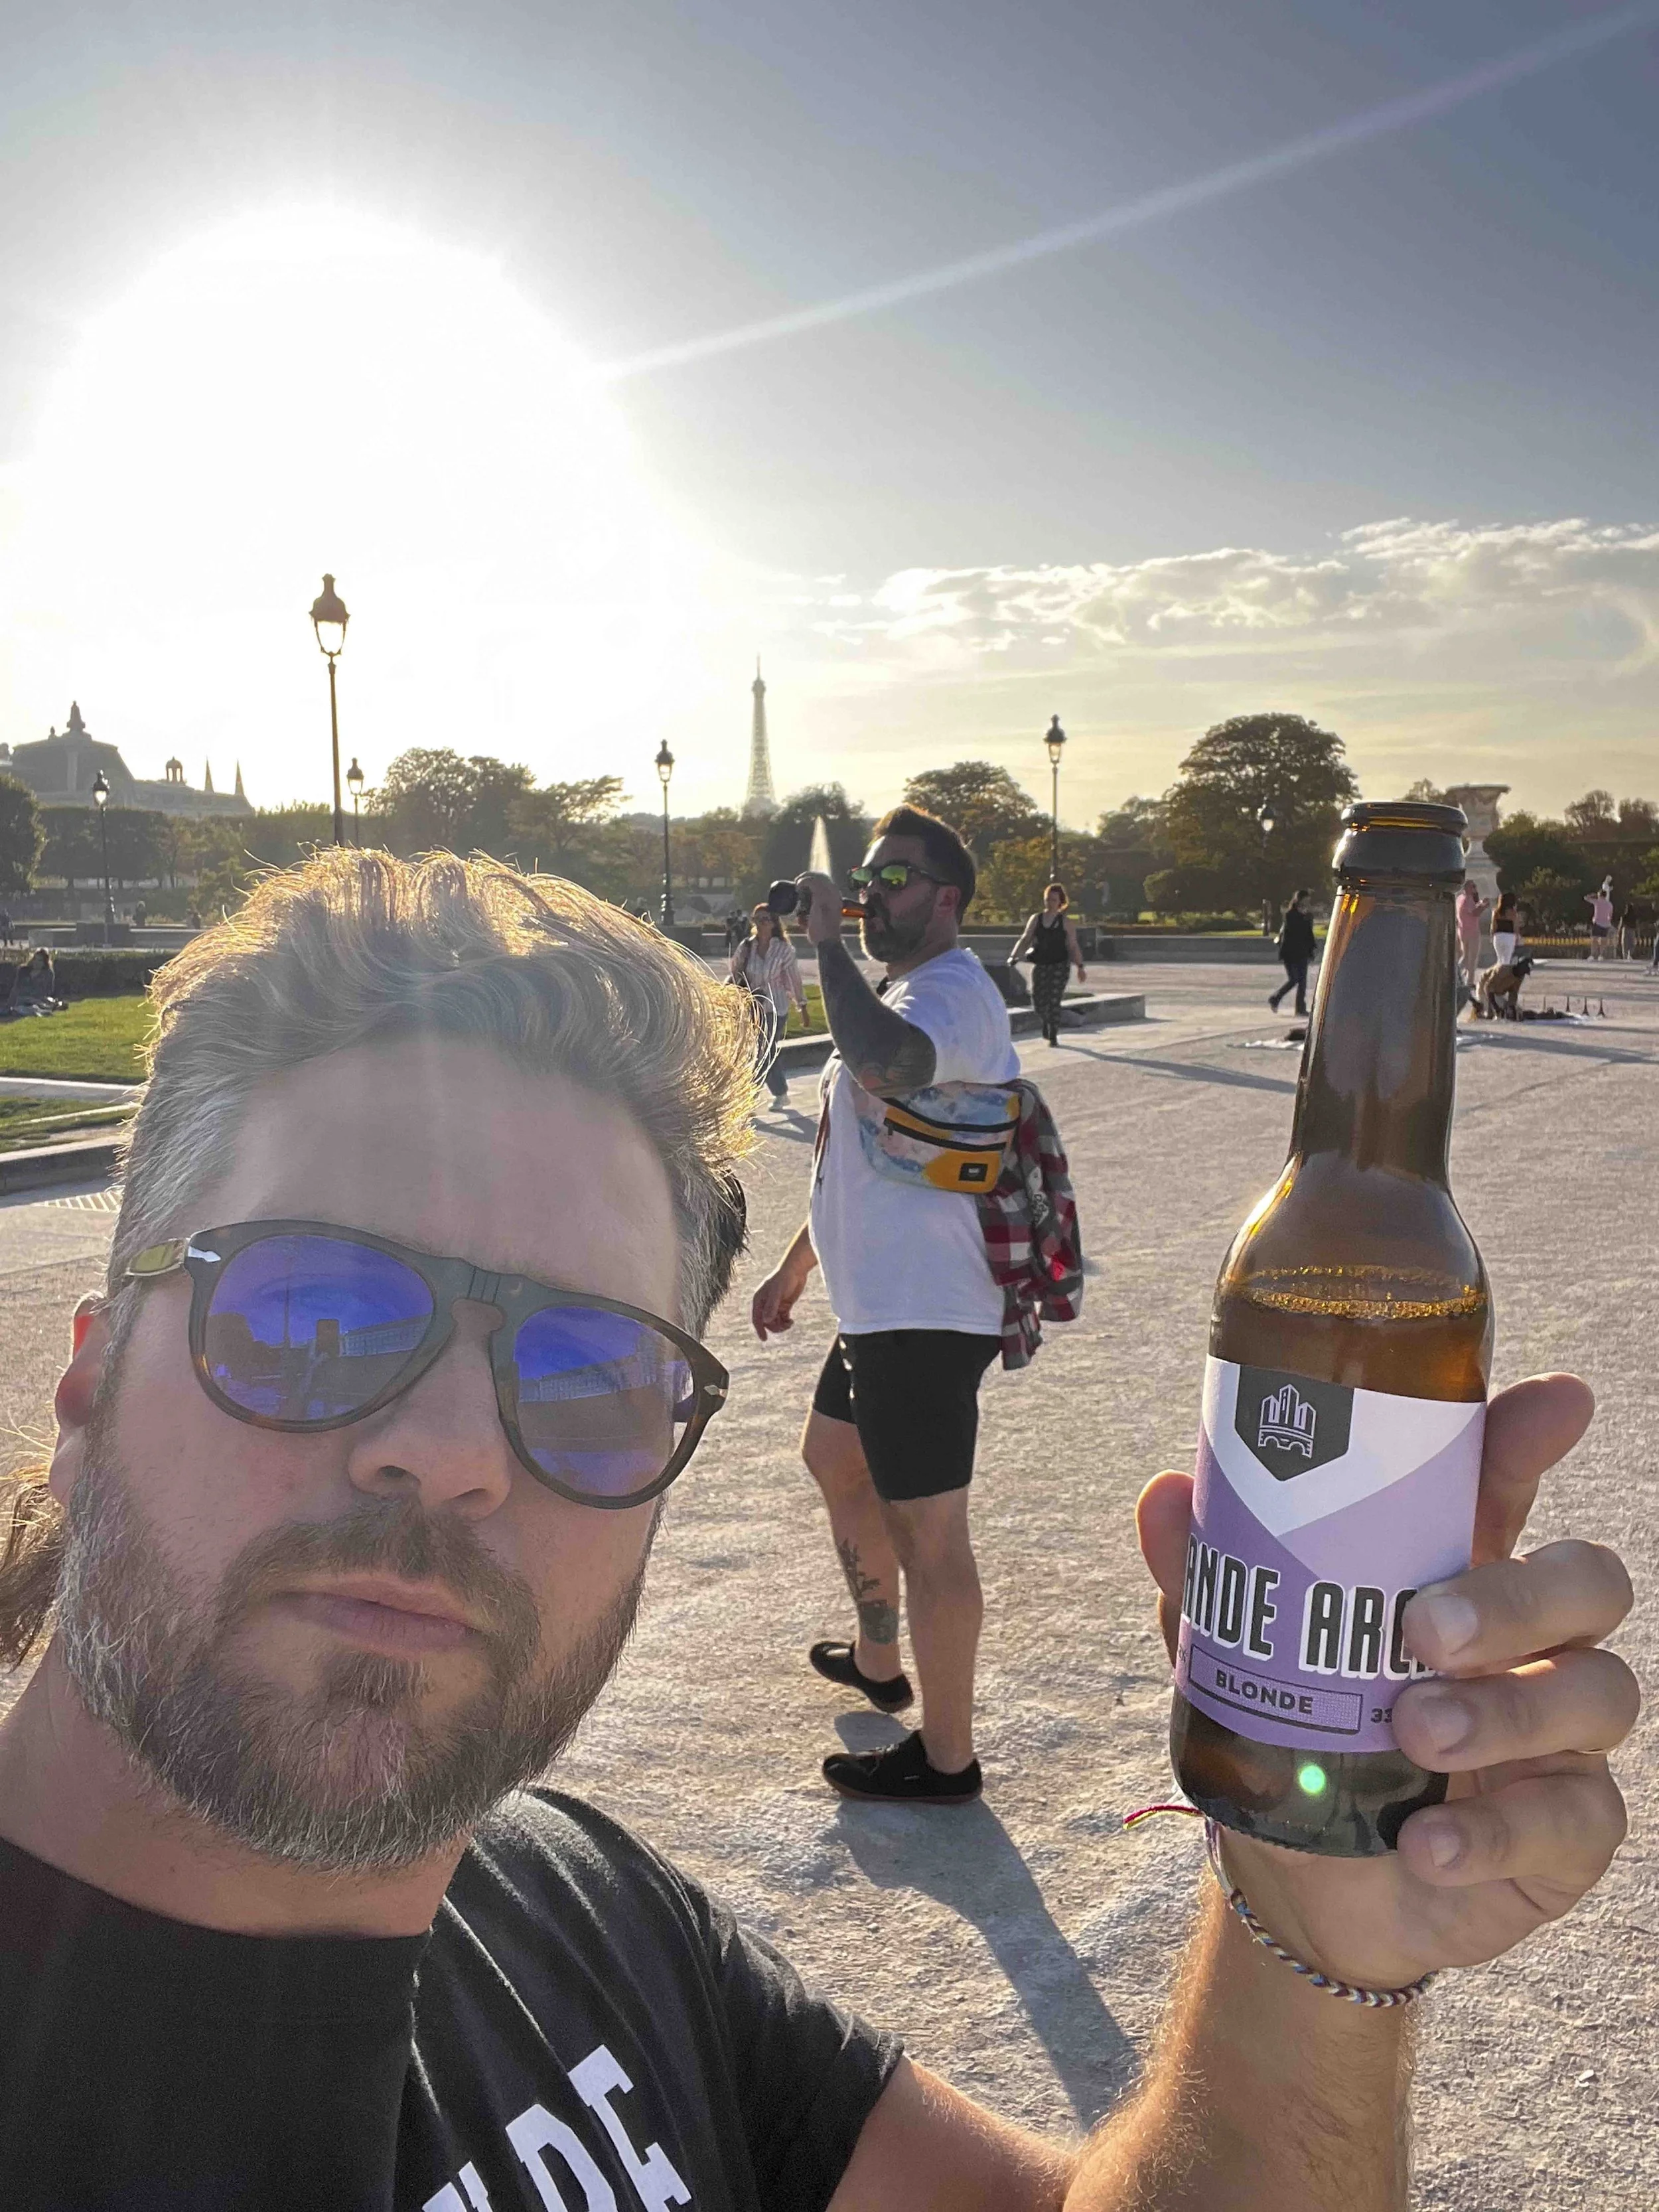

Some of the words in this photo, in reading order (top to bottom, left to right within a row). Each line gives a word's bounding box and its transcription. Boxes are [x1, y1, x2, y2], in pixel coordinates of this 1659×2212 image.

[1299, 1579, 1437, 1680] ARC
[1215, 1668, 1314, 1715] BLONDE
[421, 2043, 691, 2212] DE
